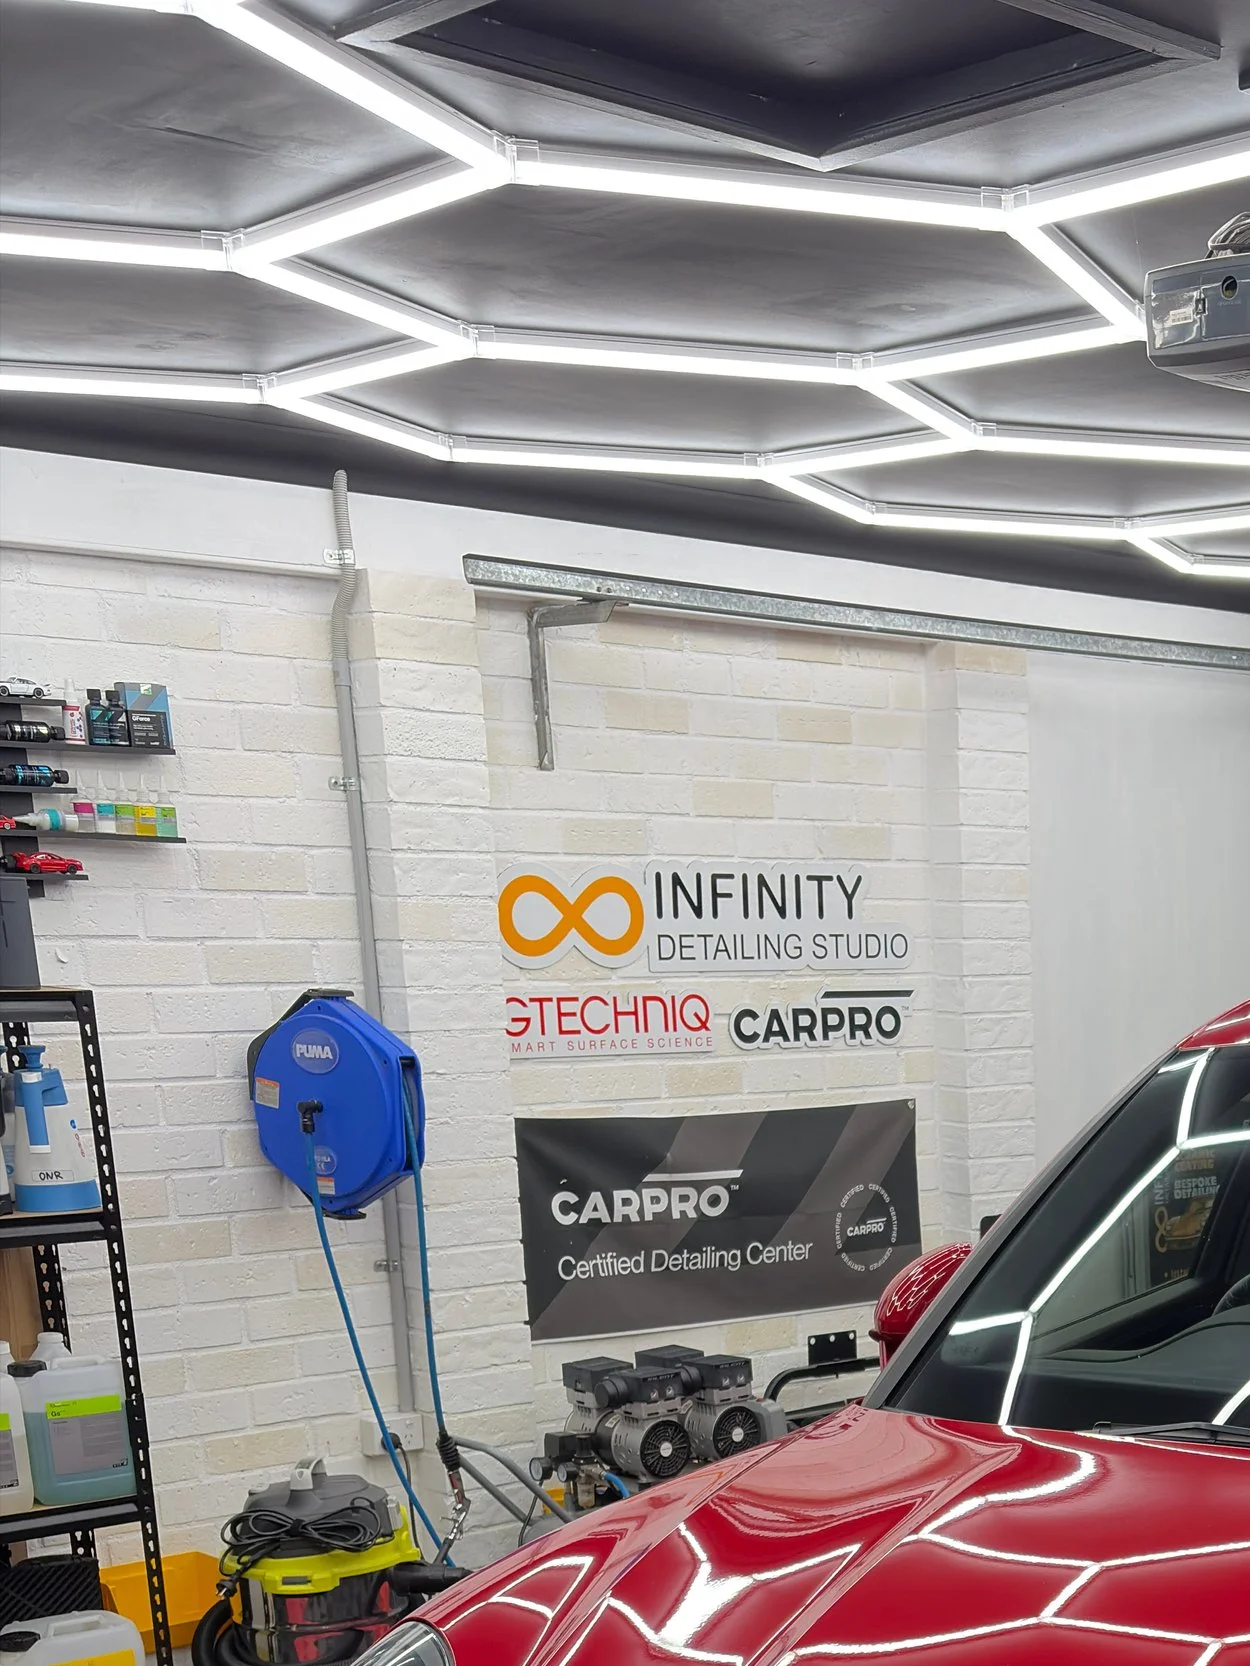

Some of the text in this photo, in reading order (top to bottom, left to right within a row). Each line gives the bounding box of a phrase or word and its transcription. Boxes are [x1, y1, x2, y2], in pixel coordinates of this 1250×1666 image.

[655, 871, 862, 920] INFINITY
[657, 933, 908, 961] DETAILING STUDIO
[505, 993, 711, 1037] GTECHNIQ
[295, 1043, 333, 1060] PUMA
[511, 1036, 713, 1053] MART SURFACE SCIENCE
[38, 1170, 64, 1181] ONR
[1174, 1176, 1218, 1189] BESPOKE
[840, 1184, 865, 1208] CERTIFIED
[868, 1183, 891, 1203] CERTIFIED
[846, 1222, 884, 1237] CARPRO
[889, 1206, 898, 1243] CERTIFIED
[557, 1240, 814, 1281] Certified Detailing Center
[841, 1252, 866, 1272] CERTIFIED
[869, 1247, 893, 1271] CERTIFIED
